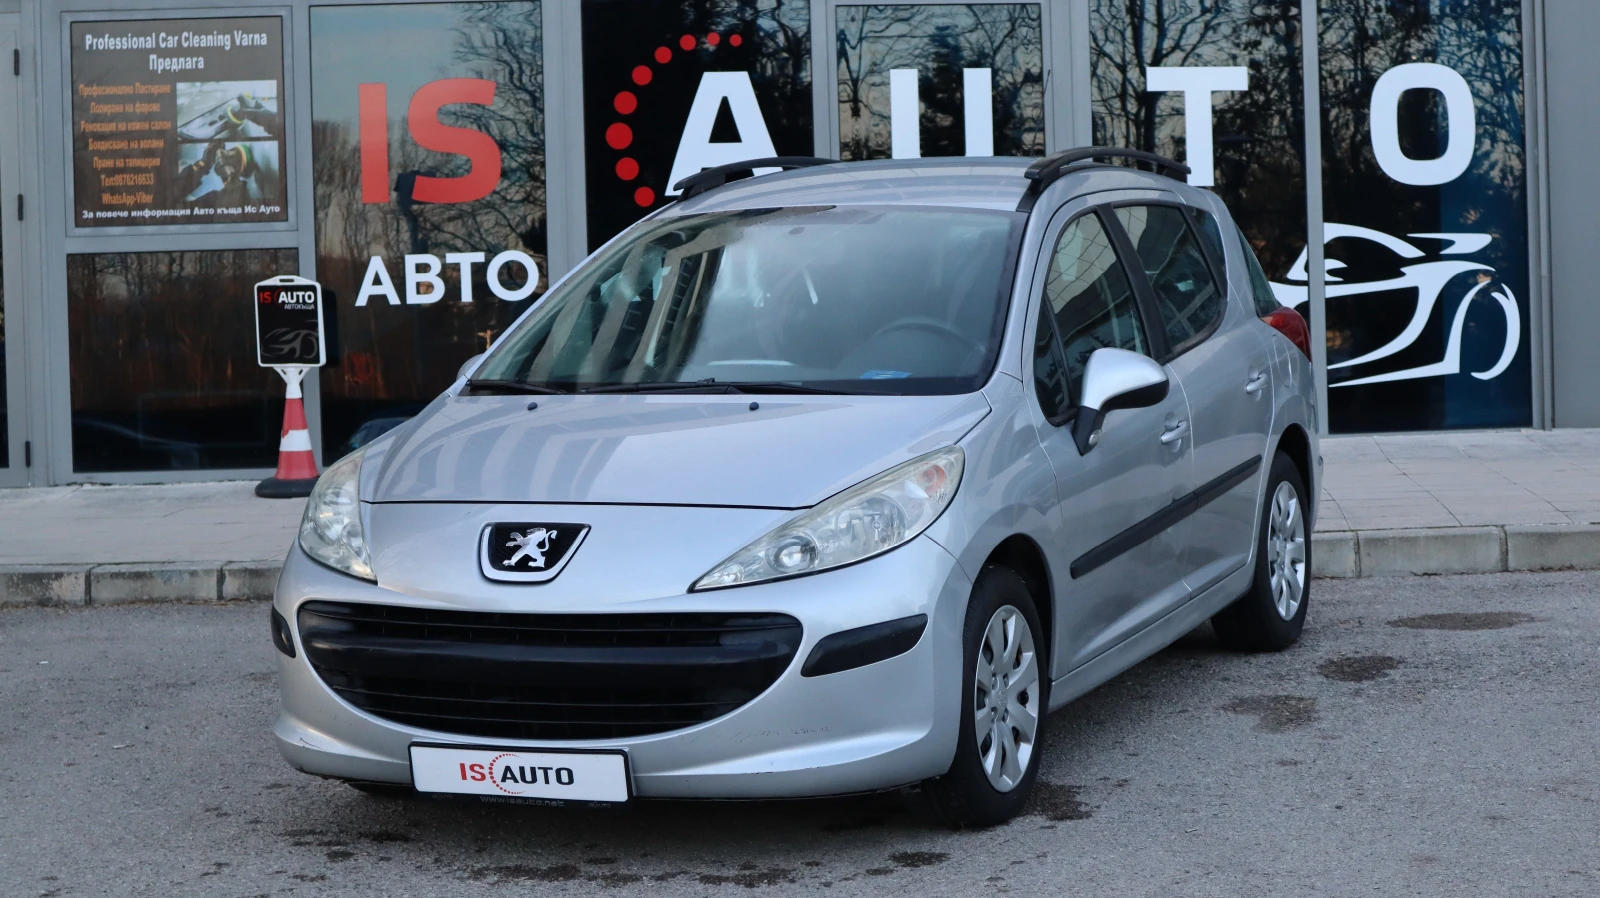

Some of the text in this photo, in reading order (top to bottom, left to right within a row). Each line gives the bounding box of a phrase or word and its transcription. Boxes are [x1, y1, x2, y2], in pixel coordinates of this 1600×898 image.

[85, 30, 267, 51] Professional Car Cleaning Varna
[149, 54, 204, 74] Предлага
[90, 101, 160, 115] Полиране на фарове
[118, 122, 126, 132] на
[151, 120, 171, 130] салон
[130, 140, 138, 149] на
[140, 139, 164, 149] волани
[358, 77, 502, 204] IS
[93, 156, 160, 171] Пране на тапицерия
[82, 204, 280, 220] За повече информация Авто къща Ис Ауто
[355, 249, 540, 307] АВТО
[259, 291, 315, 304] IS AUTO
[459, 763, 575, 786] IS AUTO
[480, 795, 565, 808] www.isauto.net
